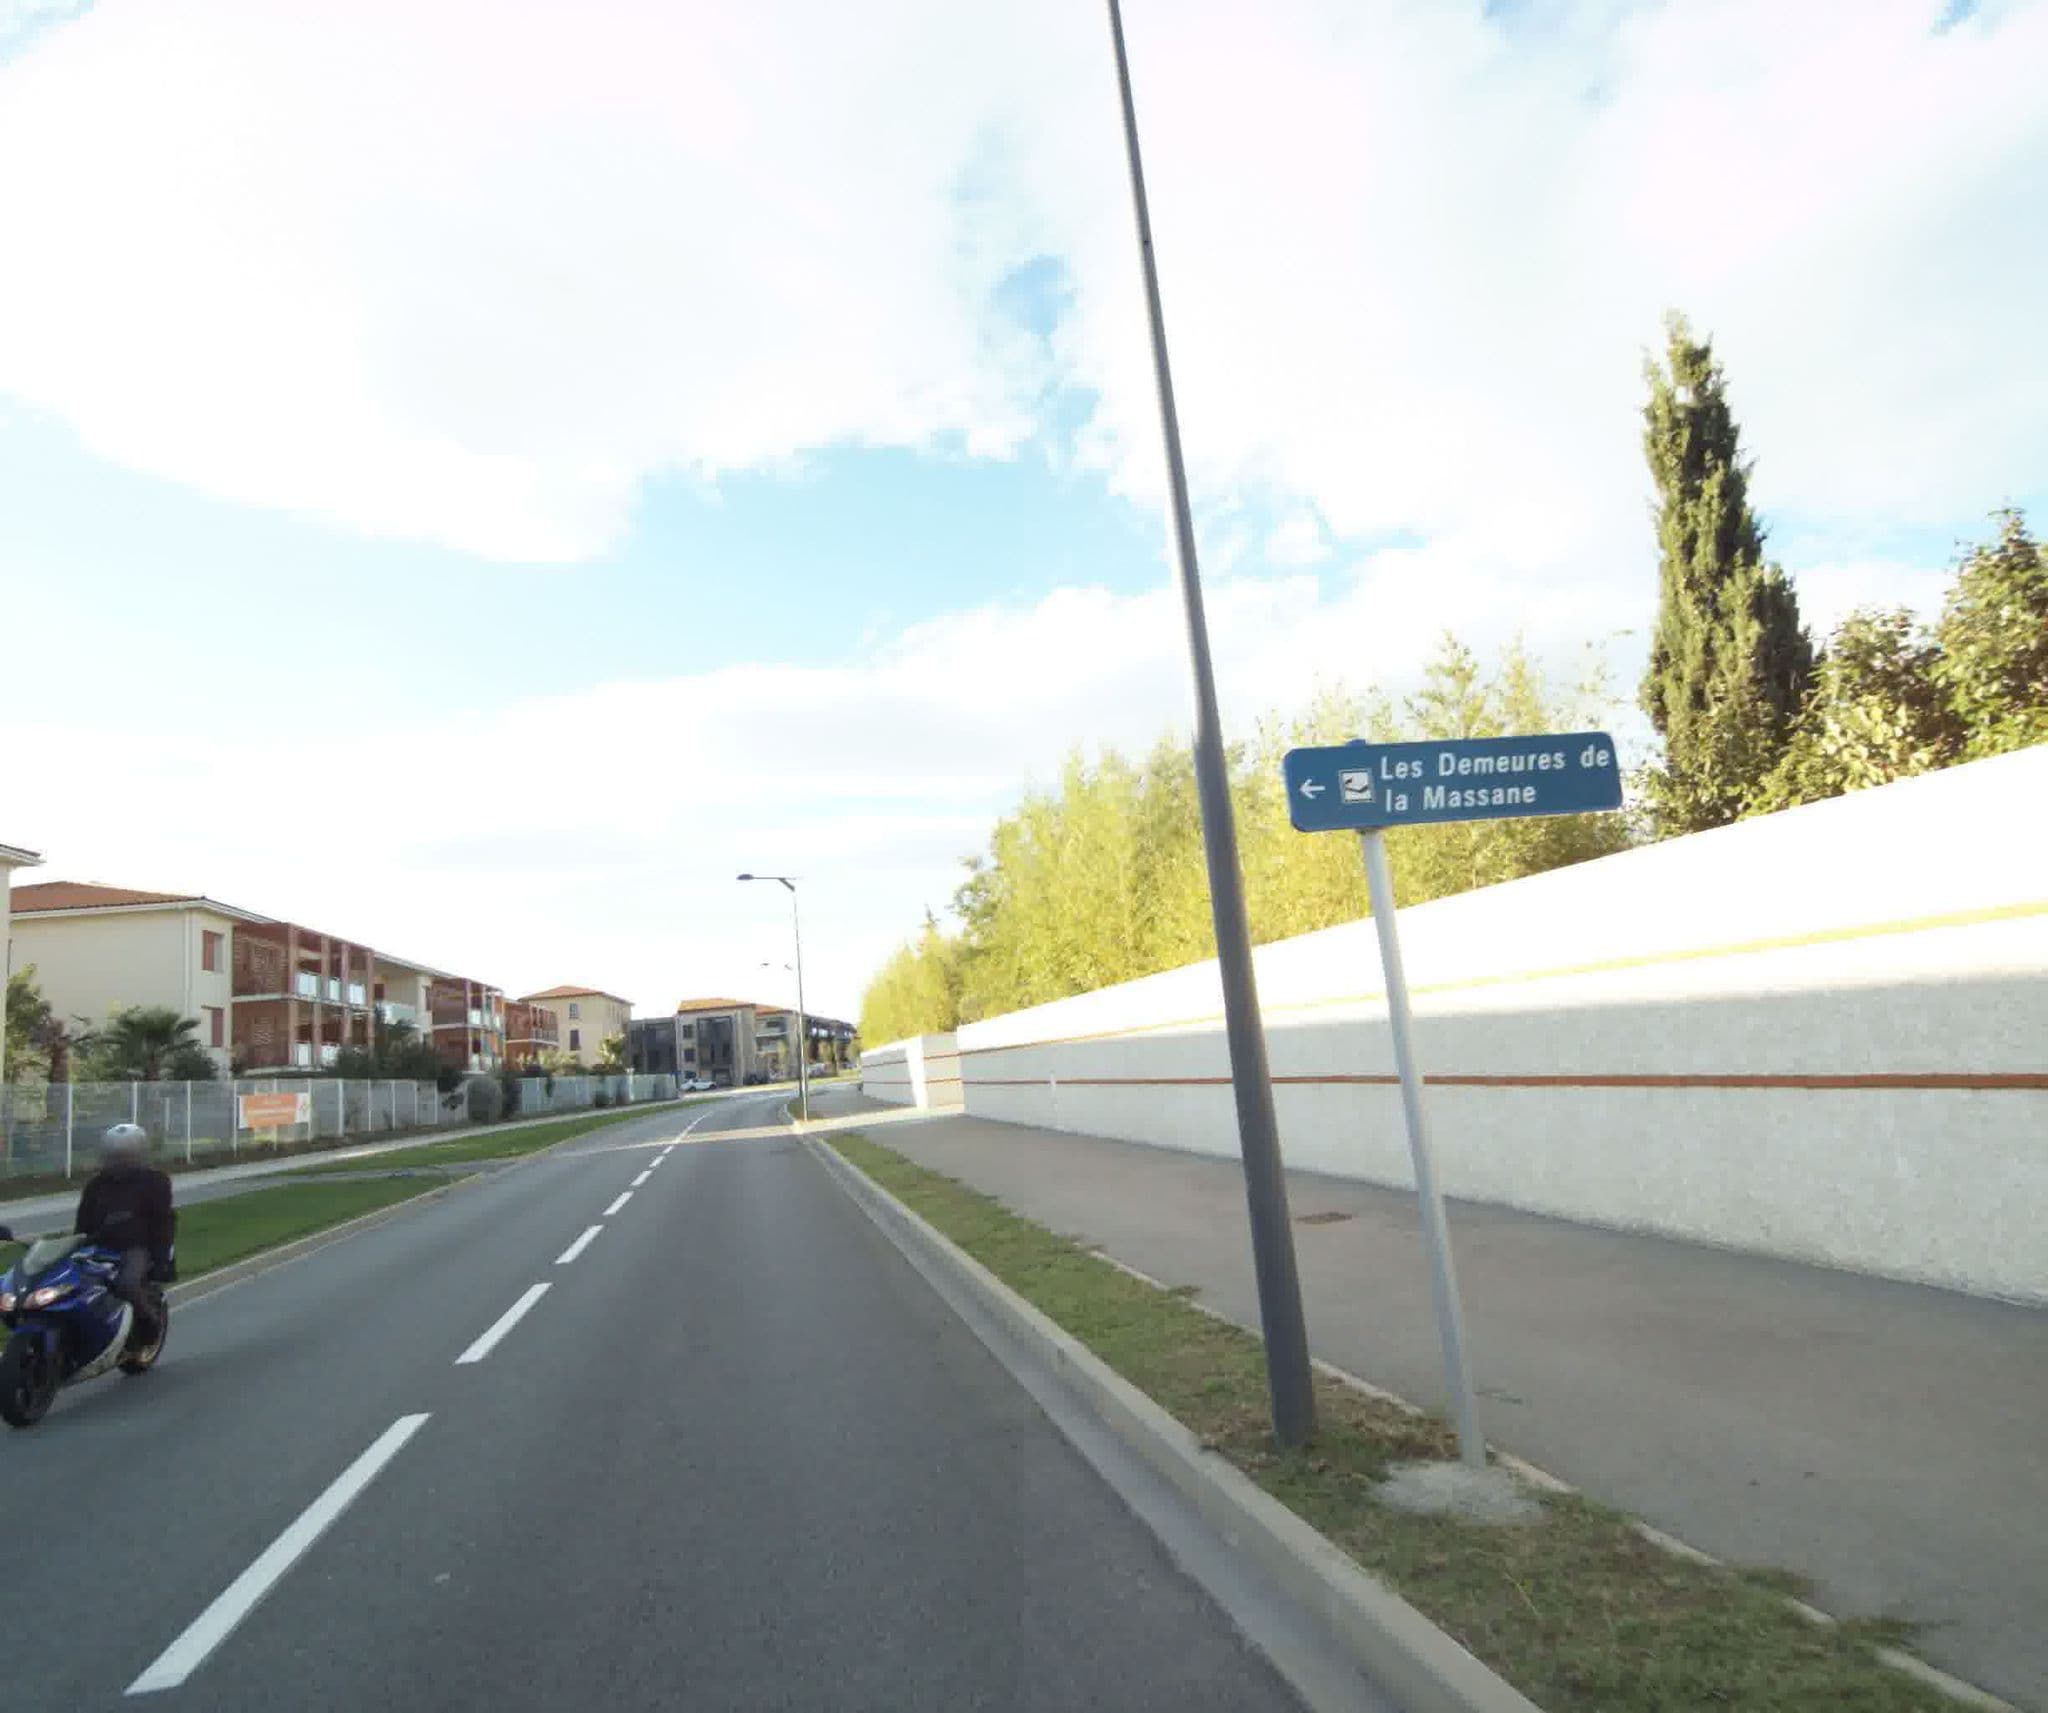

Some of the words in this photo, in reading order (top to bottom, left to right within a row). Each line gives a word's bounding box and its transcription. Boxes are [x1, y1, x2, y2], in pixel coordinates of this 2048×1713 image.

[1381, 755, 1423, 780] Les
[1438, 749, 1566, 777] Demeures
[1579, 744, 1610, 768] de
[1385, 788, 1408, 812] la
[1423, 783, 1536, 810] Massane
